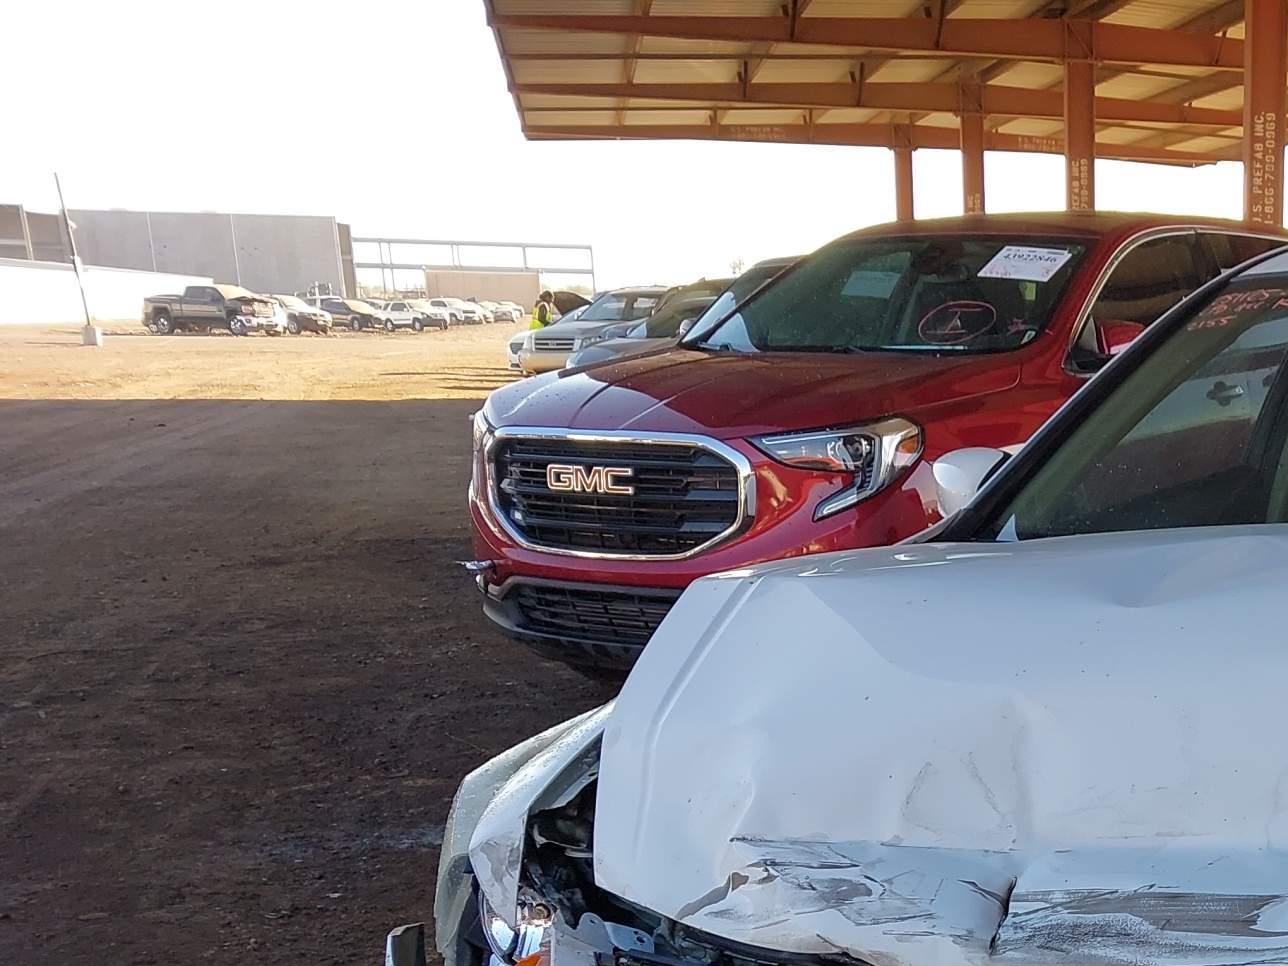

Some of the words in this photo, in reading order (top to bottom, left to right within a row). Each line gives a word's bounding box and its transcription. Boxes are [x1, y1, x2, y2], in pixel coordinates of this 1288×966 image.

[1254, 111, 1265, 136] INC.
[1253, 143, 1264, 194] PREFAB
[547, 464, 634, 494] GMC
